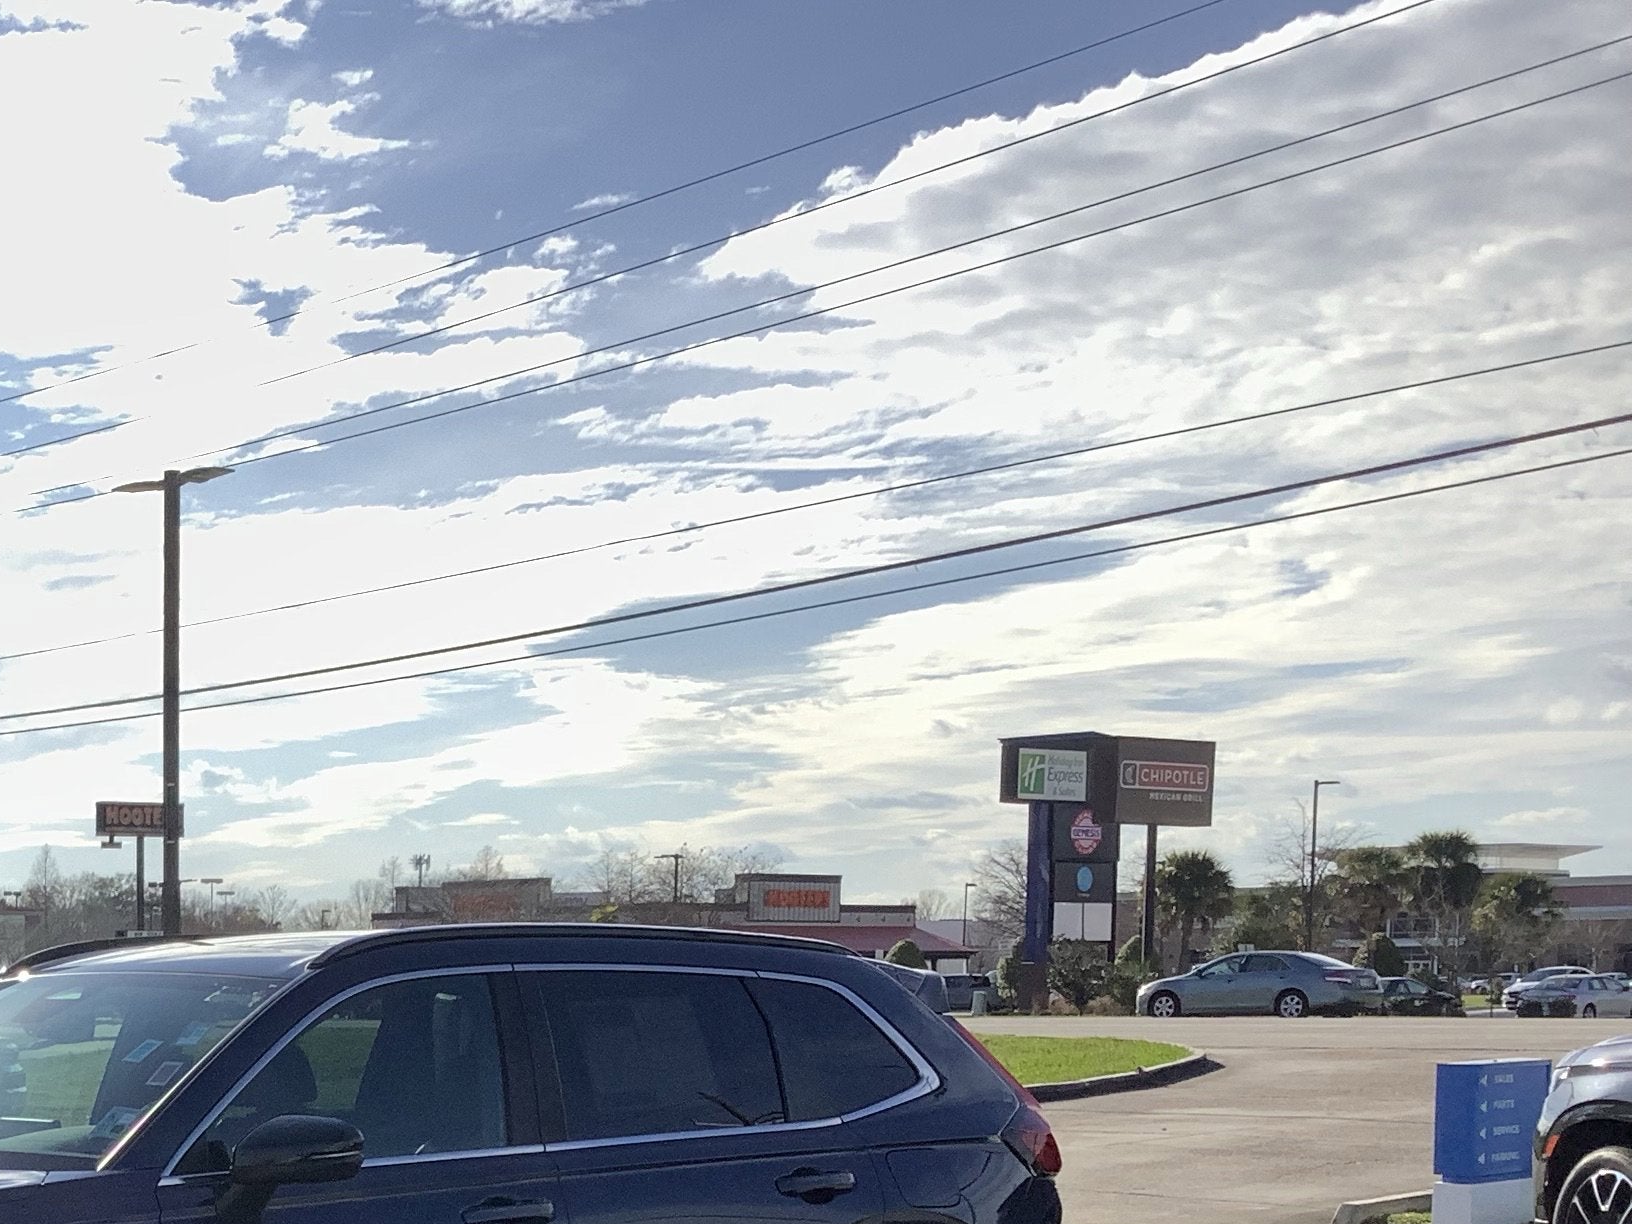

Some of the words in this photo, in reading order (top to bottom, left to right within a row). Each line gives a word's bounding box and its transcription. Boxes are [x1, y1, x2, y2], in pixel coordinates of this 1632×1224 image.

[1047, 766, 1084, 784] Express
[1141, 768, 1205, 784] CHIPOTLE
[106, 805, 163, 826] HOOTE
[1493, 1125, 1520, 1136] SERVICE
